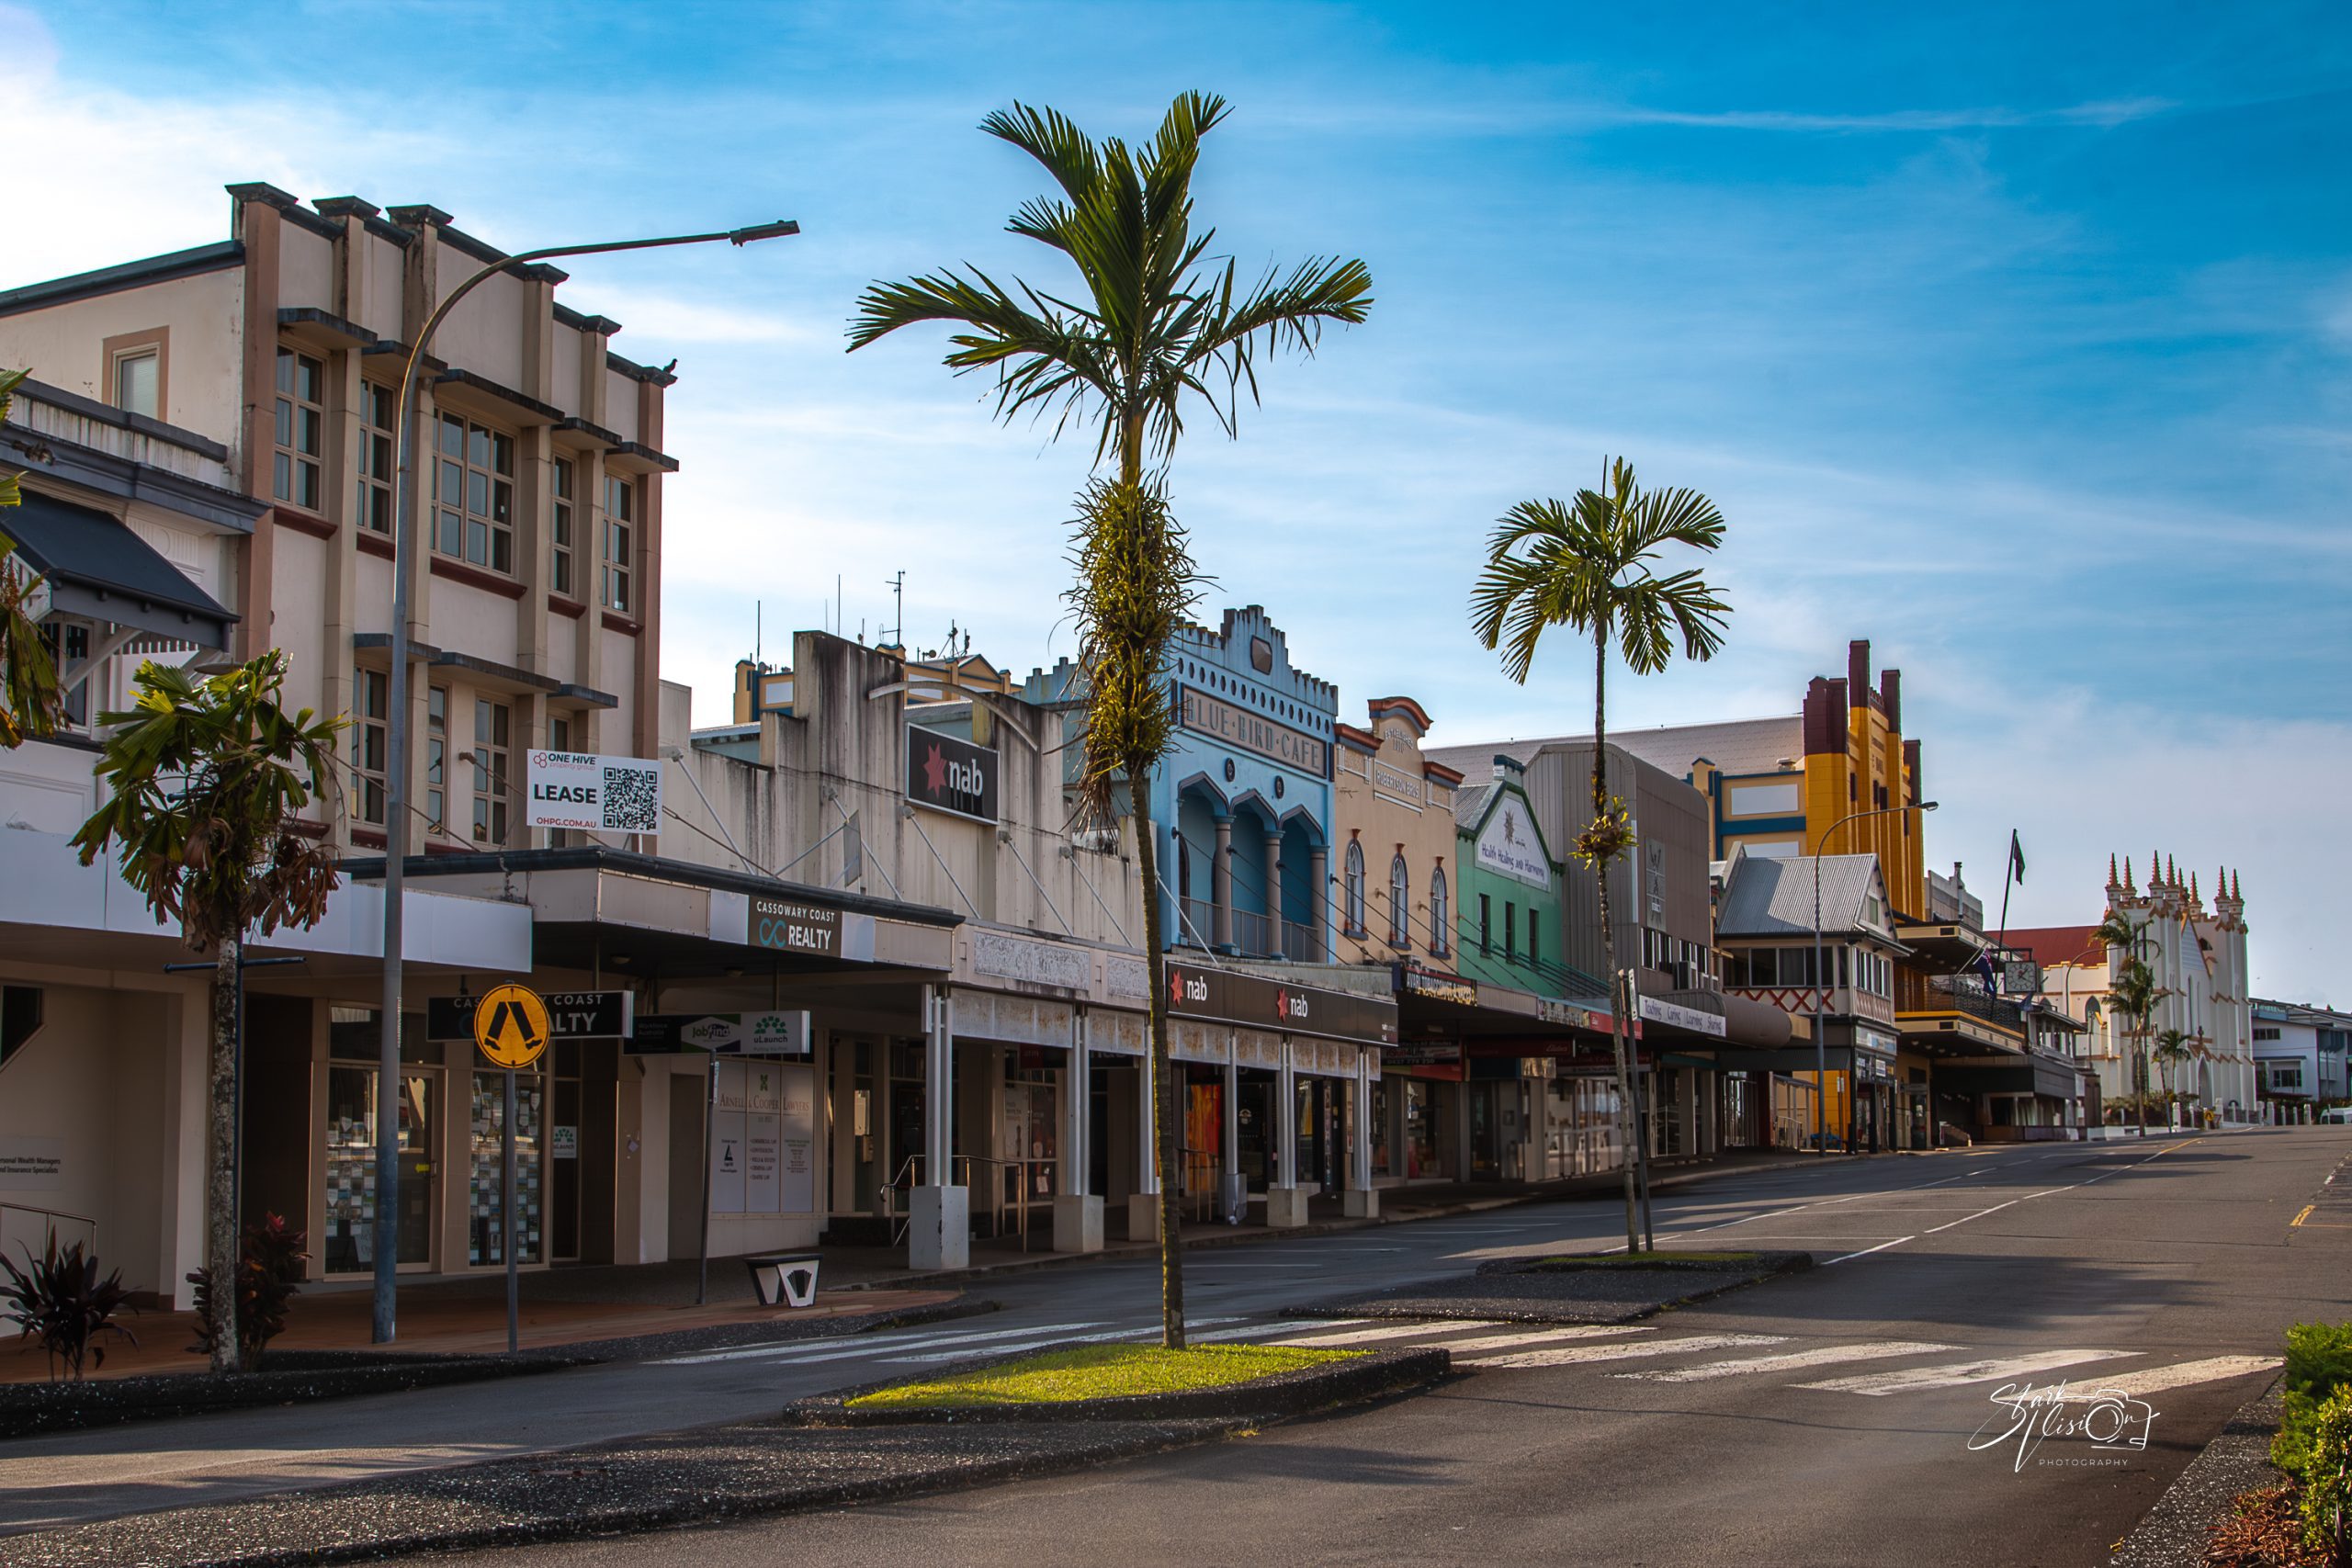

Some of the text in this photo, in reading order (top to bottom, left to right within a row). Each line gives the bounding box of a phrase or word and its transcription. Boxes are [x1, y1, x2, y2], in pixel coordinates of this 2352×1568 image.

[1185, 692, 1320, 770] BLUE BIRD CAFE
[548, 752, 596, 765] ONE HIVE
[549, 761, 576, 771] property
[949, 758, 983, 796] nab
[1375, 770, 1407, 795] ROBERTSON
[534, 784, 597, 805] LEASE
[536, 817, 596, 829] OHPG.COM.AU
[1481, 842, 1497, 861] Health
[1498, 849, 1514, 871] Healing
[1525, 859, 1544, 880] Harmony
[756, 901, 835, 923] CASSOWARY COAST
[788, 924, 831, 950] REALTY
[1186, 976, 1208, 1001] nab
[553, 994, 604, 1006] COAST
[1290, 993, 1308, 1018] nab
[1645, 999, 1662, 1021] Teaching
[1668, 1006, 1681, 1025] Caring
[1708, 1015, 1722, 1034] Sharing
[753, 1034, 788, 1043] uLaunch
[33, 1166, 59, 1175] Specialists
[37, 1156, 61, 1167] Managers
